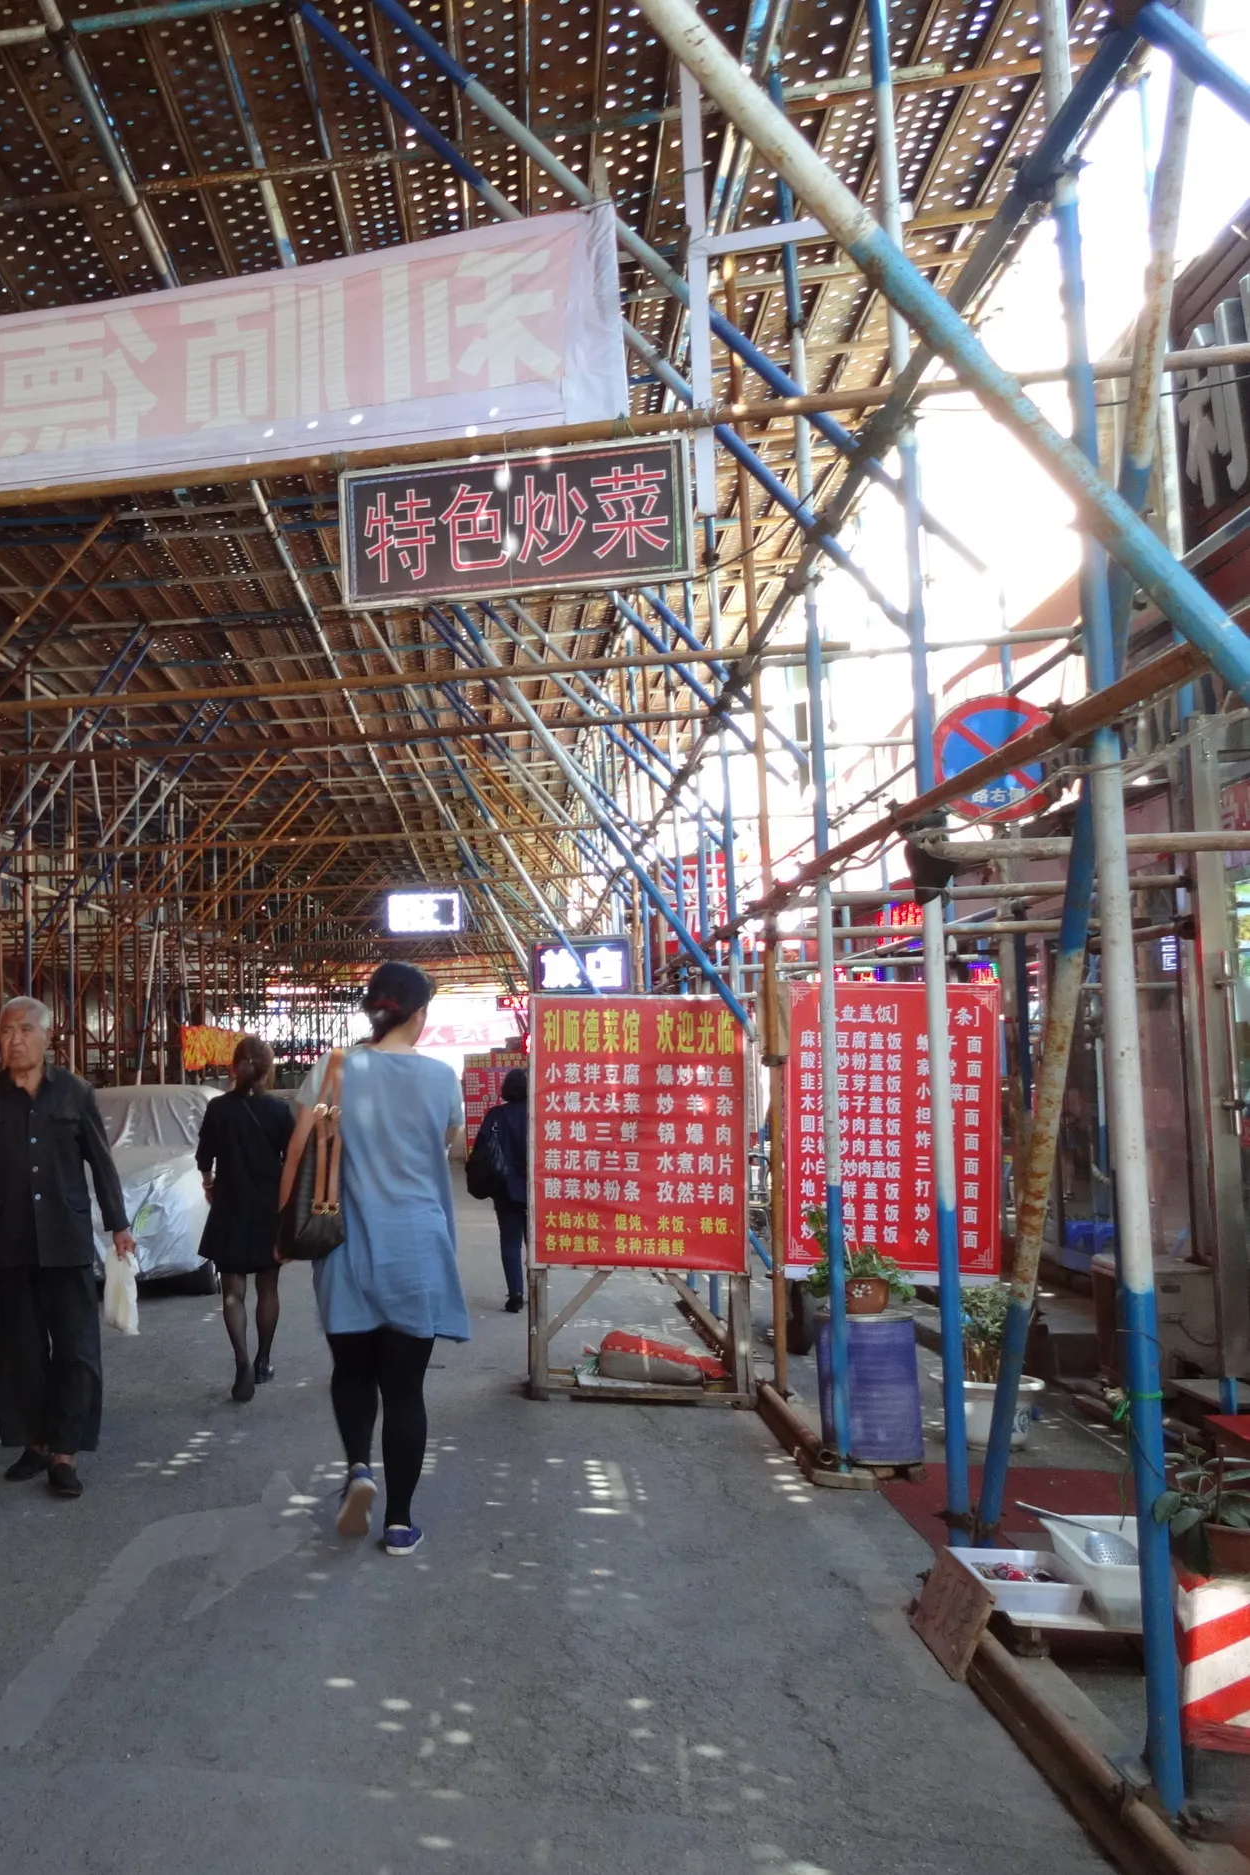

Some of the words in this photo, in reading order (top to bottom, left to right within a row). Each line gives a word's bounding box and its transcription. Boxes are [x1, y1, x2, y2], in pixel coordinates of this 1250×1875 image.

[364, 463, 670, 584] 特色炒菜
[543, 1008, 641, 1054] 利顺德菜馆
[656, 1009, 735, 1055] 欢迎光临
[800, 1030, 902, 1051] 麻豆腐盖饭
[800, 1051, 902, 1072] 酸炒粉盖饭
[544, 1062, 641, 1086] 小葱拌豆腐
[656, 1063, 735, 1087] 爆炒鱿鱼
[800, 1072, 902, 1093] 韭豆芽盖饭
[544, 1091, 641, 1115] 火爆大头菜
[656, 1093, 734, 1117] 炒羊杂
[915, 1082, 981, 1103] 小菜面
[544, 1119, 639, 1144] 烧地三鲜
[544, 1148, 641, 1172] 蒜泥荷兰豆
[656, 1151, 735, 1176] 水煮肉片
[800, 1157, 901, 1179] 小白炒肉盖饭
[544, 1178, 641, 1202] 酸菜炒粉条
[656, 1181, 735, 1206] 孜然羊肉
